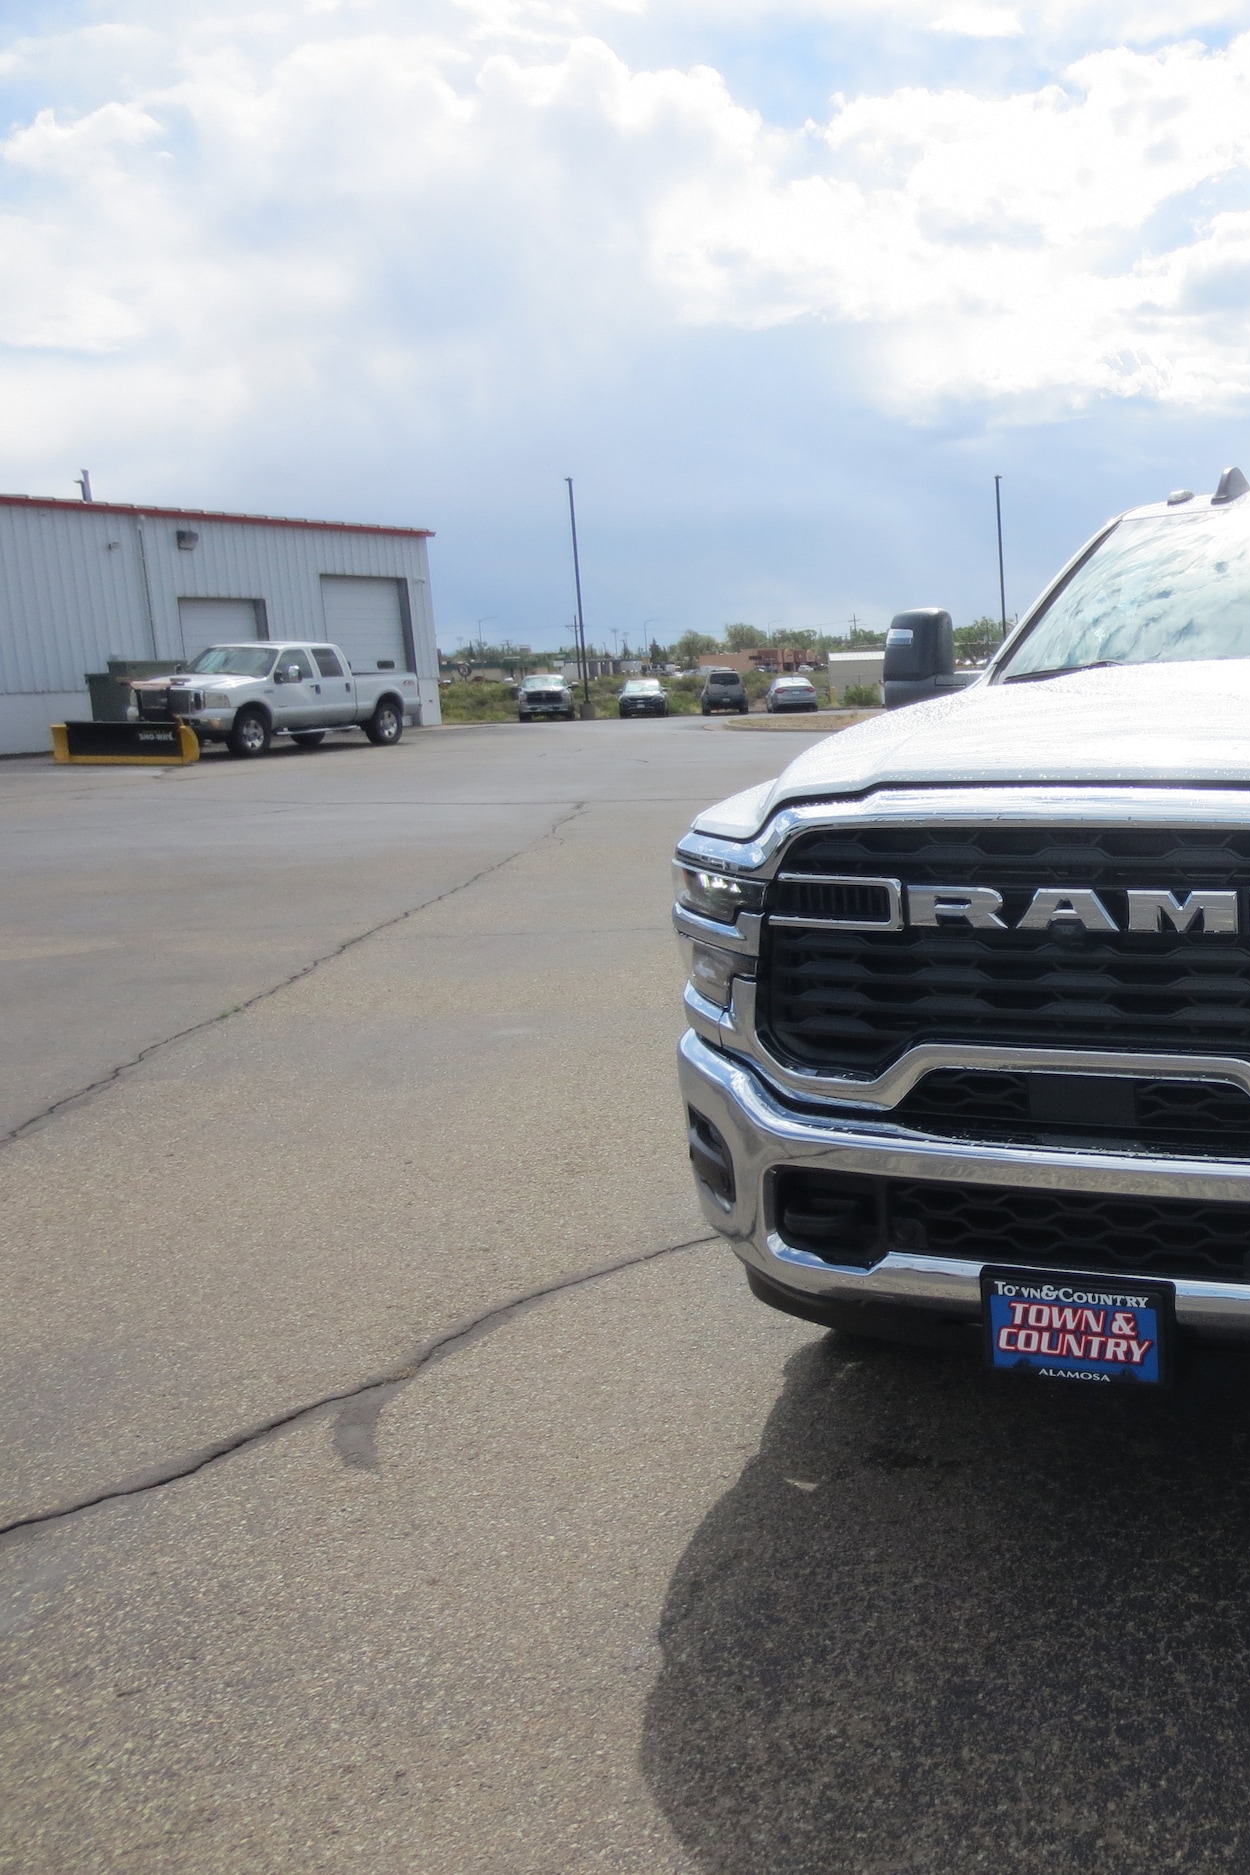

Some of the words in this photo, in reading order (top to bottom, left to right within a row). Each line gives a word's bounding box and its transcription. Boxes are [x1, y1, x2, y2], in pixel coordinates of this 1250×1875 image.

[907, 885, 1239, 934] RAM
[1009, 1302, 1105, 1333] TOWN
[1111, 1312, 1137, 1336] &
[998, 1328, 1152, 1363] COUNTRY
[1038, 1368, 1111, 1382] ALAMOSA
